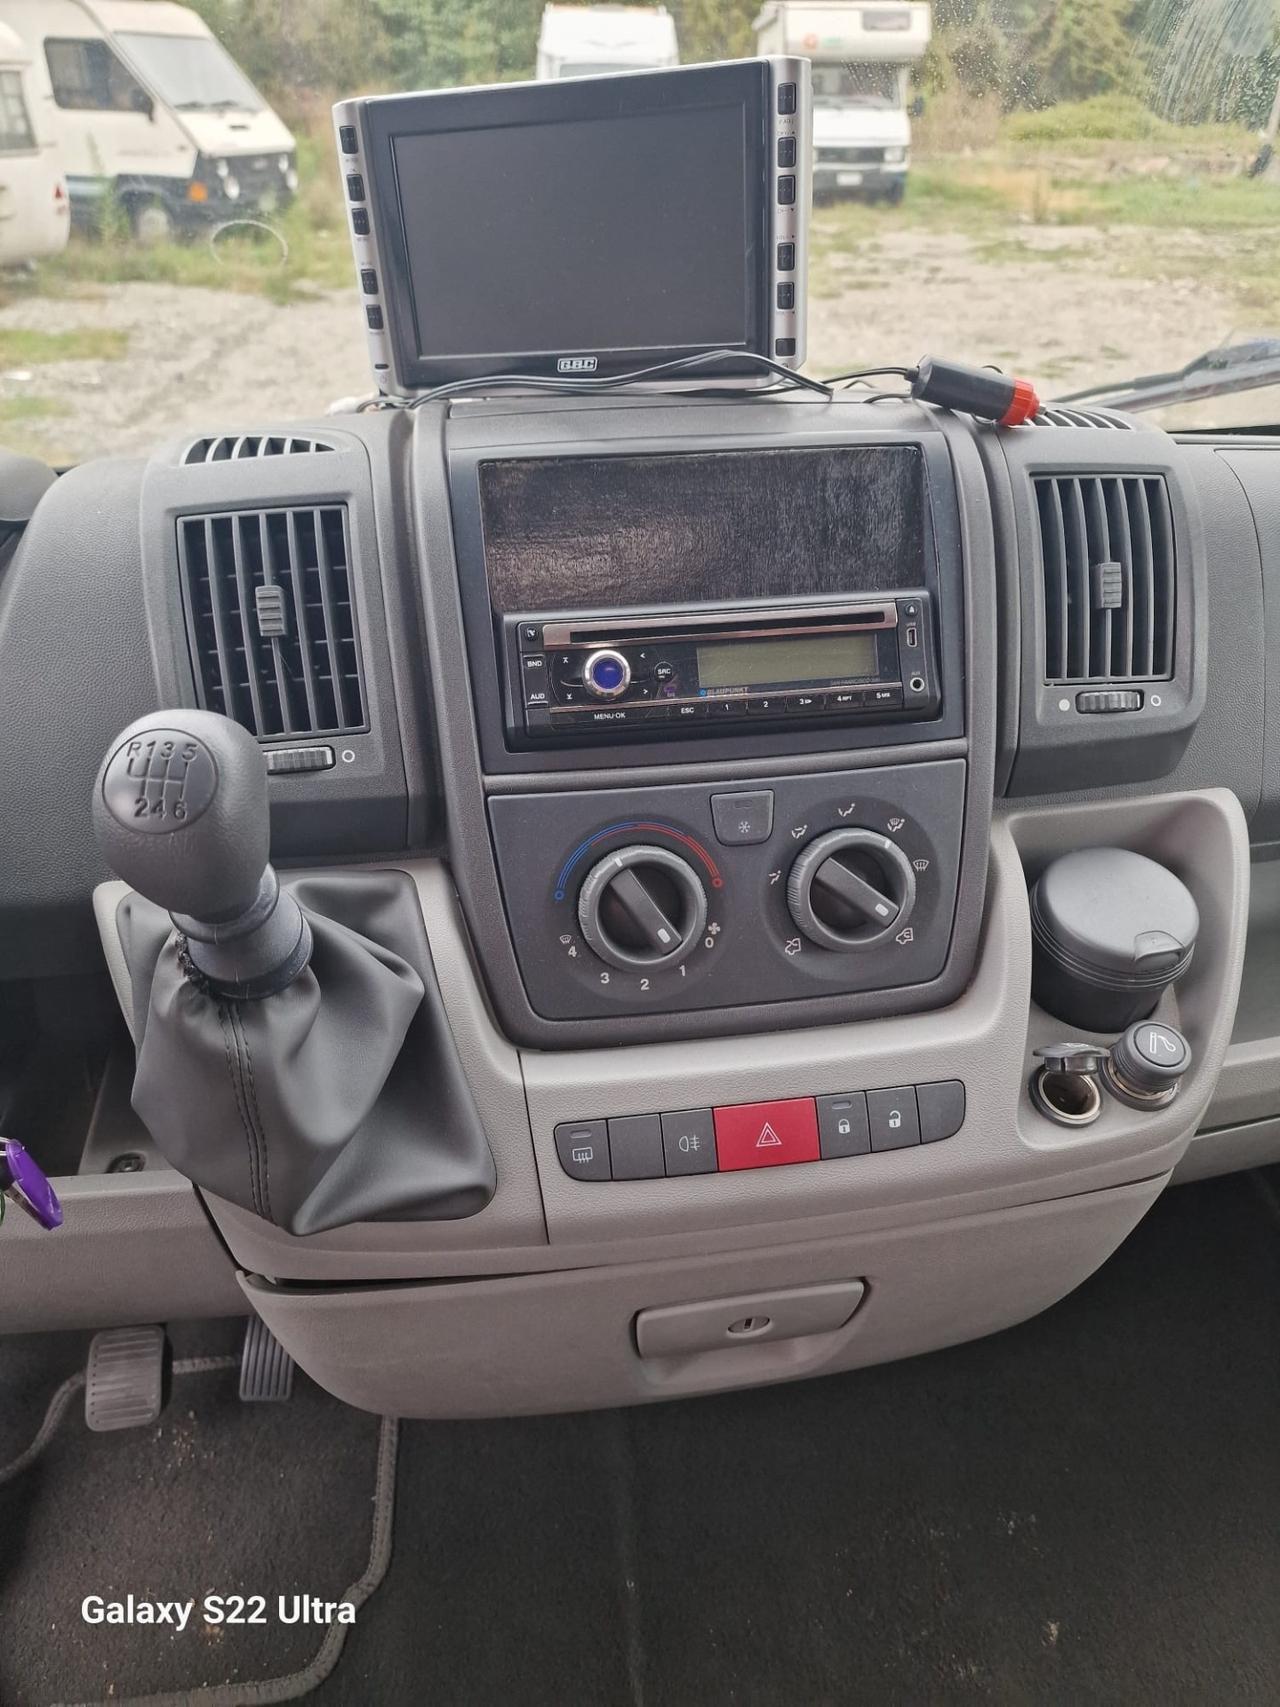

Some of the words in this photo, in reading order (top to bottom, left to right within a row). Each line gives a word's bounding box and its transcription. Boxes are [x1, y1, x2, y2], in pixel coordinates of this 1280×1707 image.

[127, 741, 142, 758] R
[146, 740, 157, 757] 1
[161, 741, 175, 761] 3
[182, 741, 198, 761] 5
[133, 799, 149, 818] 2
[151, 800, 167, 821] 4
[173, 799, 188, 820] 6
[704, 937, 714, 949] 0
[568, 946, 577, 957] 4
[679, 965, 686, 976] 1
[600, 972, 610, 984] 3
[640, 979, 650, 991] 2
